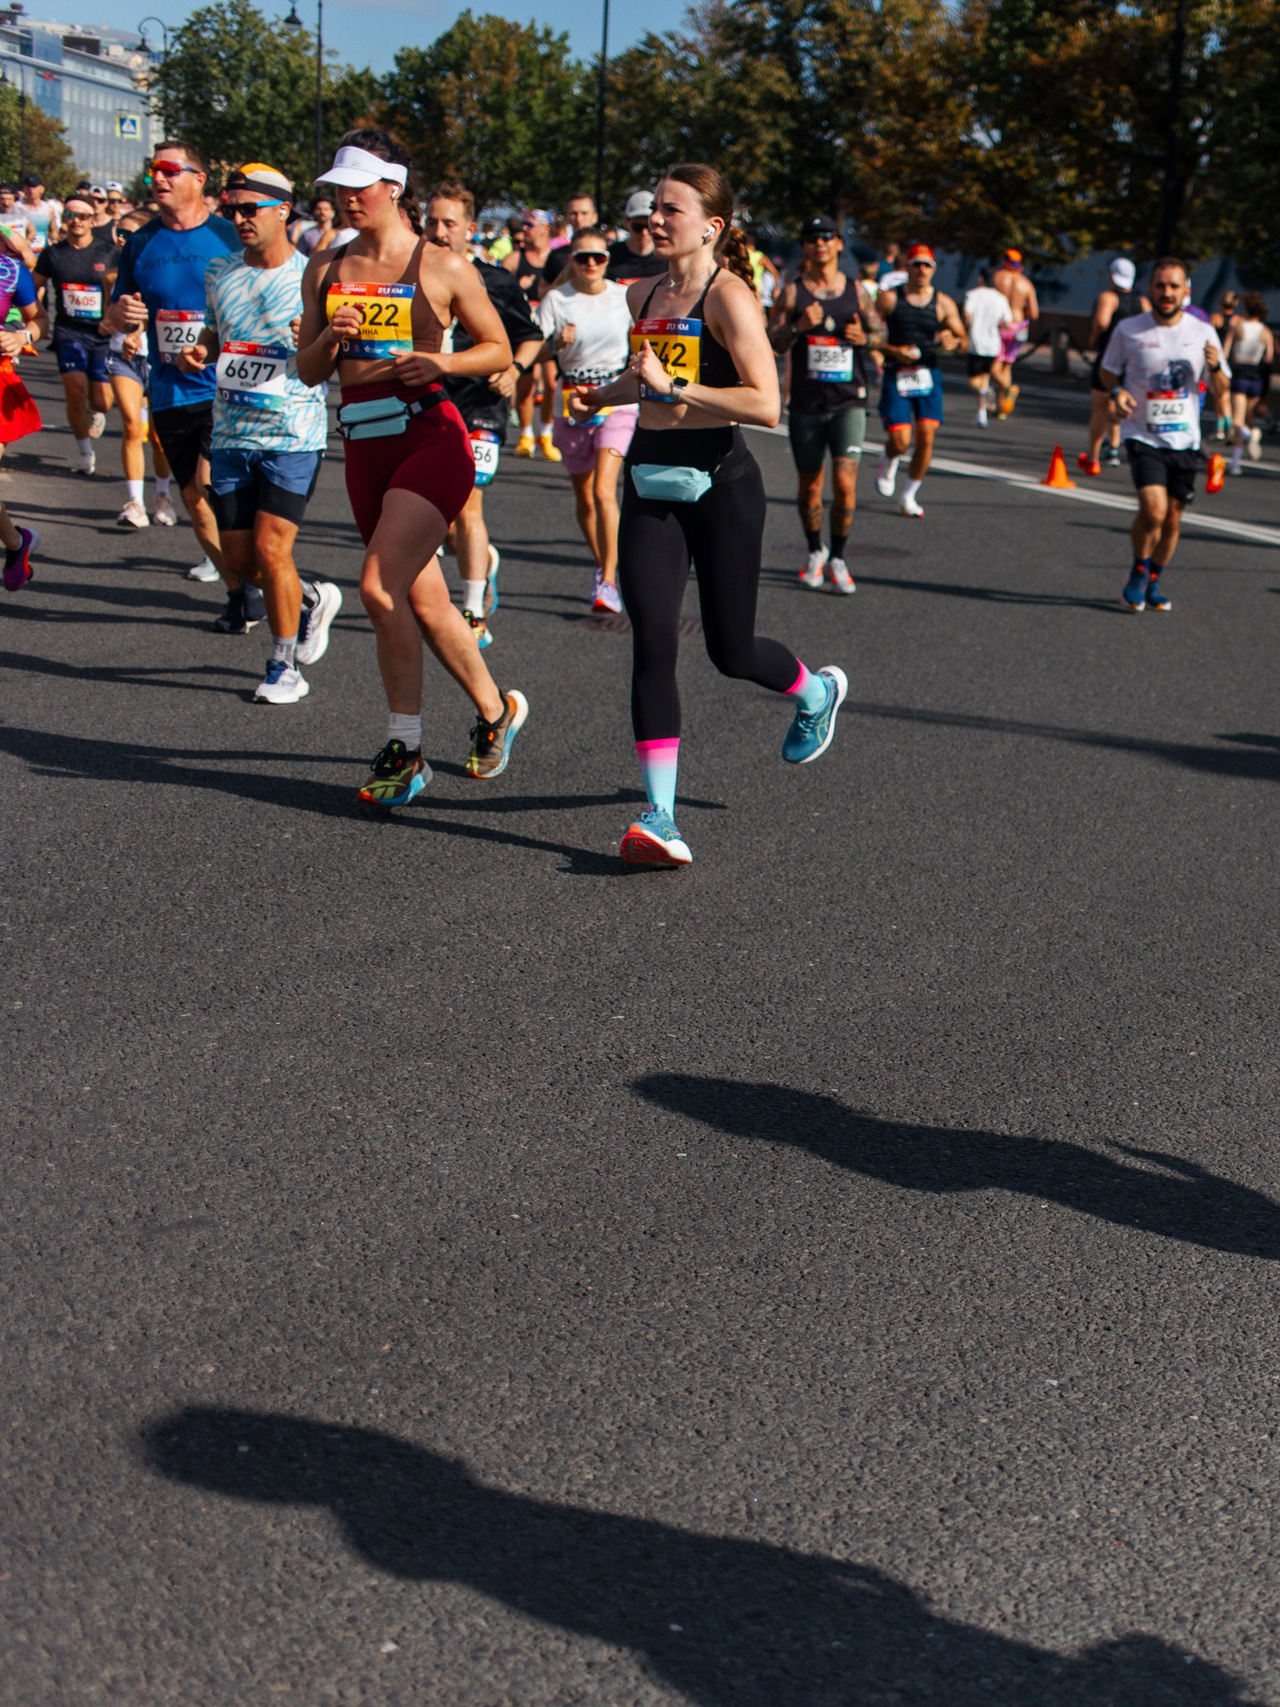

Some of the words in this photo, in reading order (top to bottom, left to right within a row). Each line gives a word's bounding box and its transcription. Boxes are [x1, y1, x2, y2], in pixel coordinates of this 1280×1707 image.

[68, 294, 96, 306] 7605
[342, 302, 399, 326] 522
[163, 326, 196, 343] 226
[639, 341, 687, 367] 542
[225, 359, 276, 382] 6677
